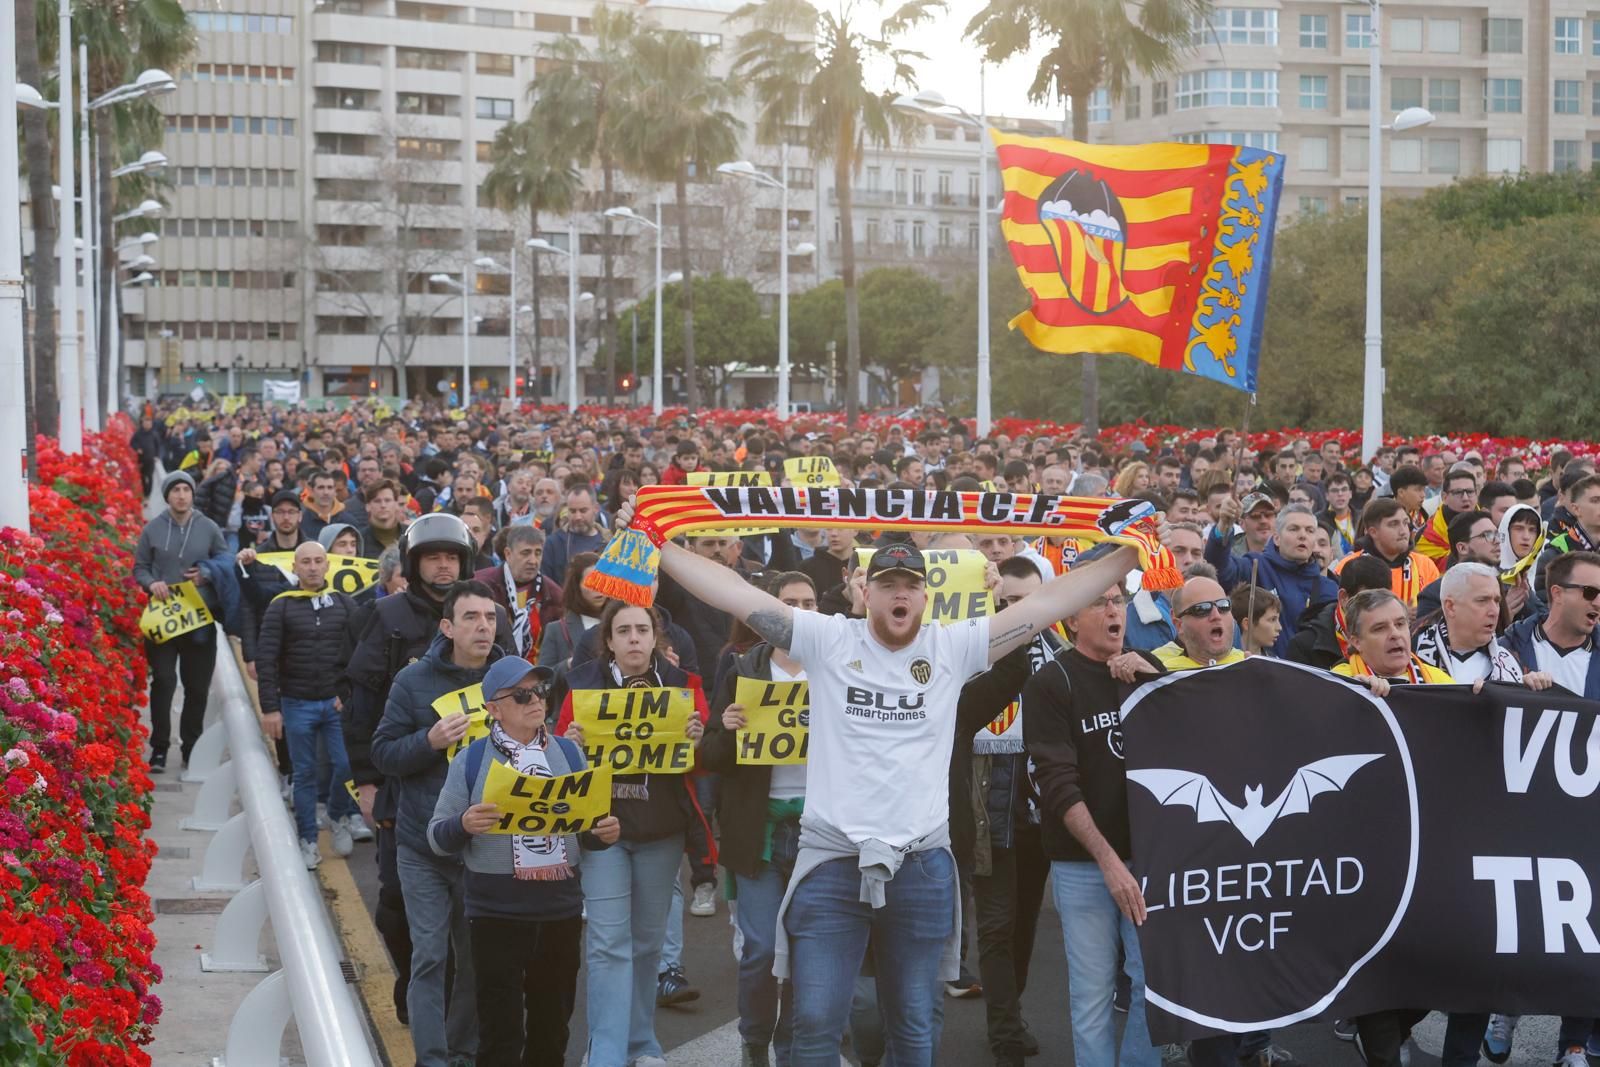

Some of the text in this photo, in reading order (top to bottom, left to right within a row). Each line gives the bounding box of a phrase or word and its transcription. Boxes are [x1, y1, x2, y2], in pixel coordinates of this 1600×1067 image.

[798, 458, 830, 473] LIM
[705, 487, 1062, 524] VALENCIA C.F.
[932, 592, 988, 620] ME
[148, 608, 207, 640] HOME
[597, 691, 671, 720] LIM
[760, 683, 809, 707] LI
[847, 686, 925, 711] BLU
[845, 706, 926, 722] smartphones
[615, 722, 654, 740] GO
[583, 743, 690, 770] HOME
[740, 732, 809, 760] HO
[510, 771, 593, 800] LIM
[1143, 856, 1364, 913] LIBERTAD
[1472, 855, 1600, 954] TR
[1204, 911, 1293, 955] VCF
